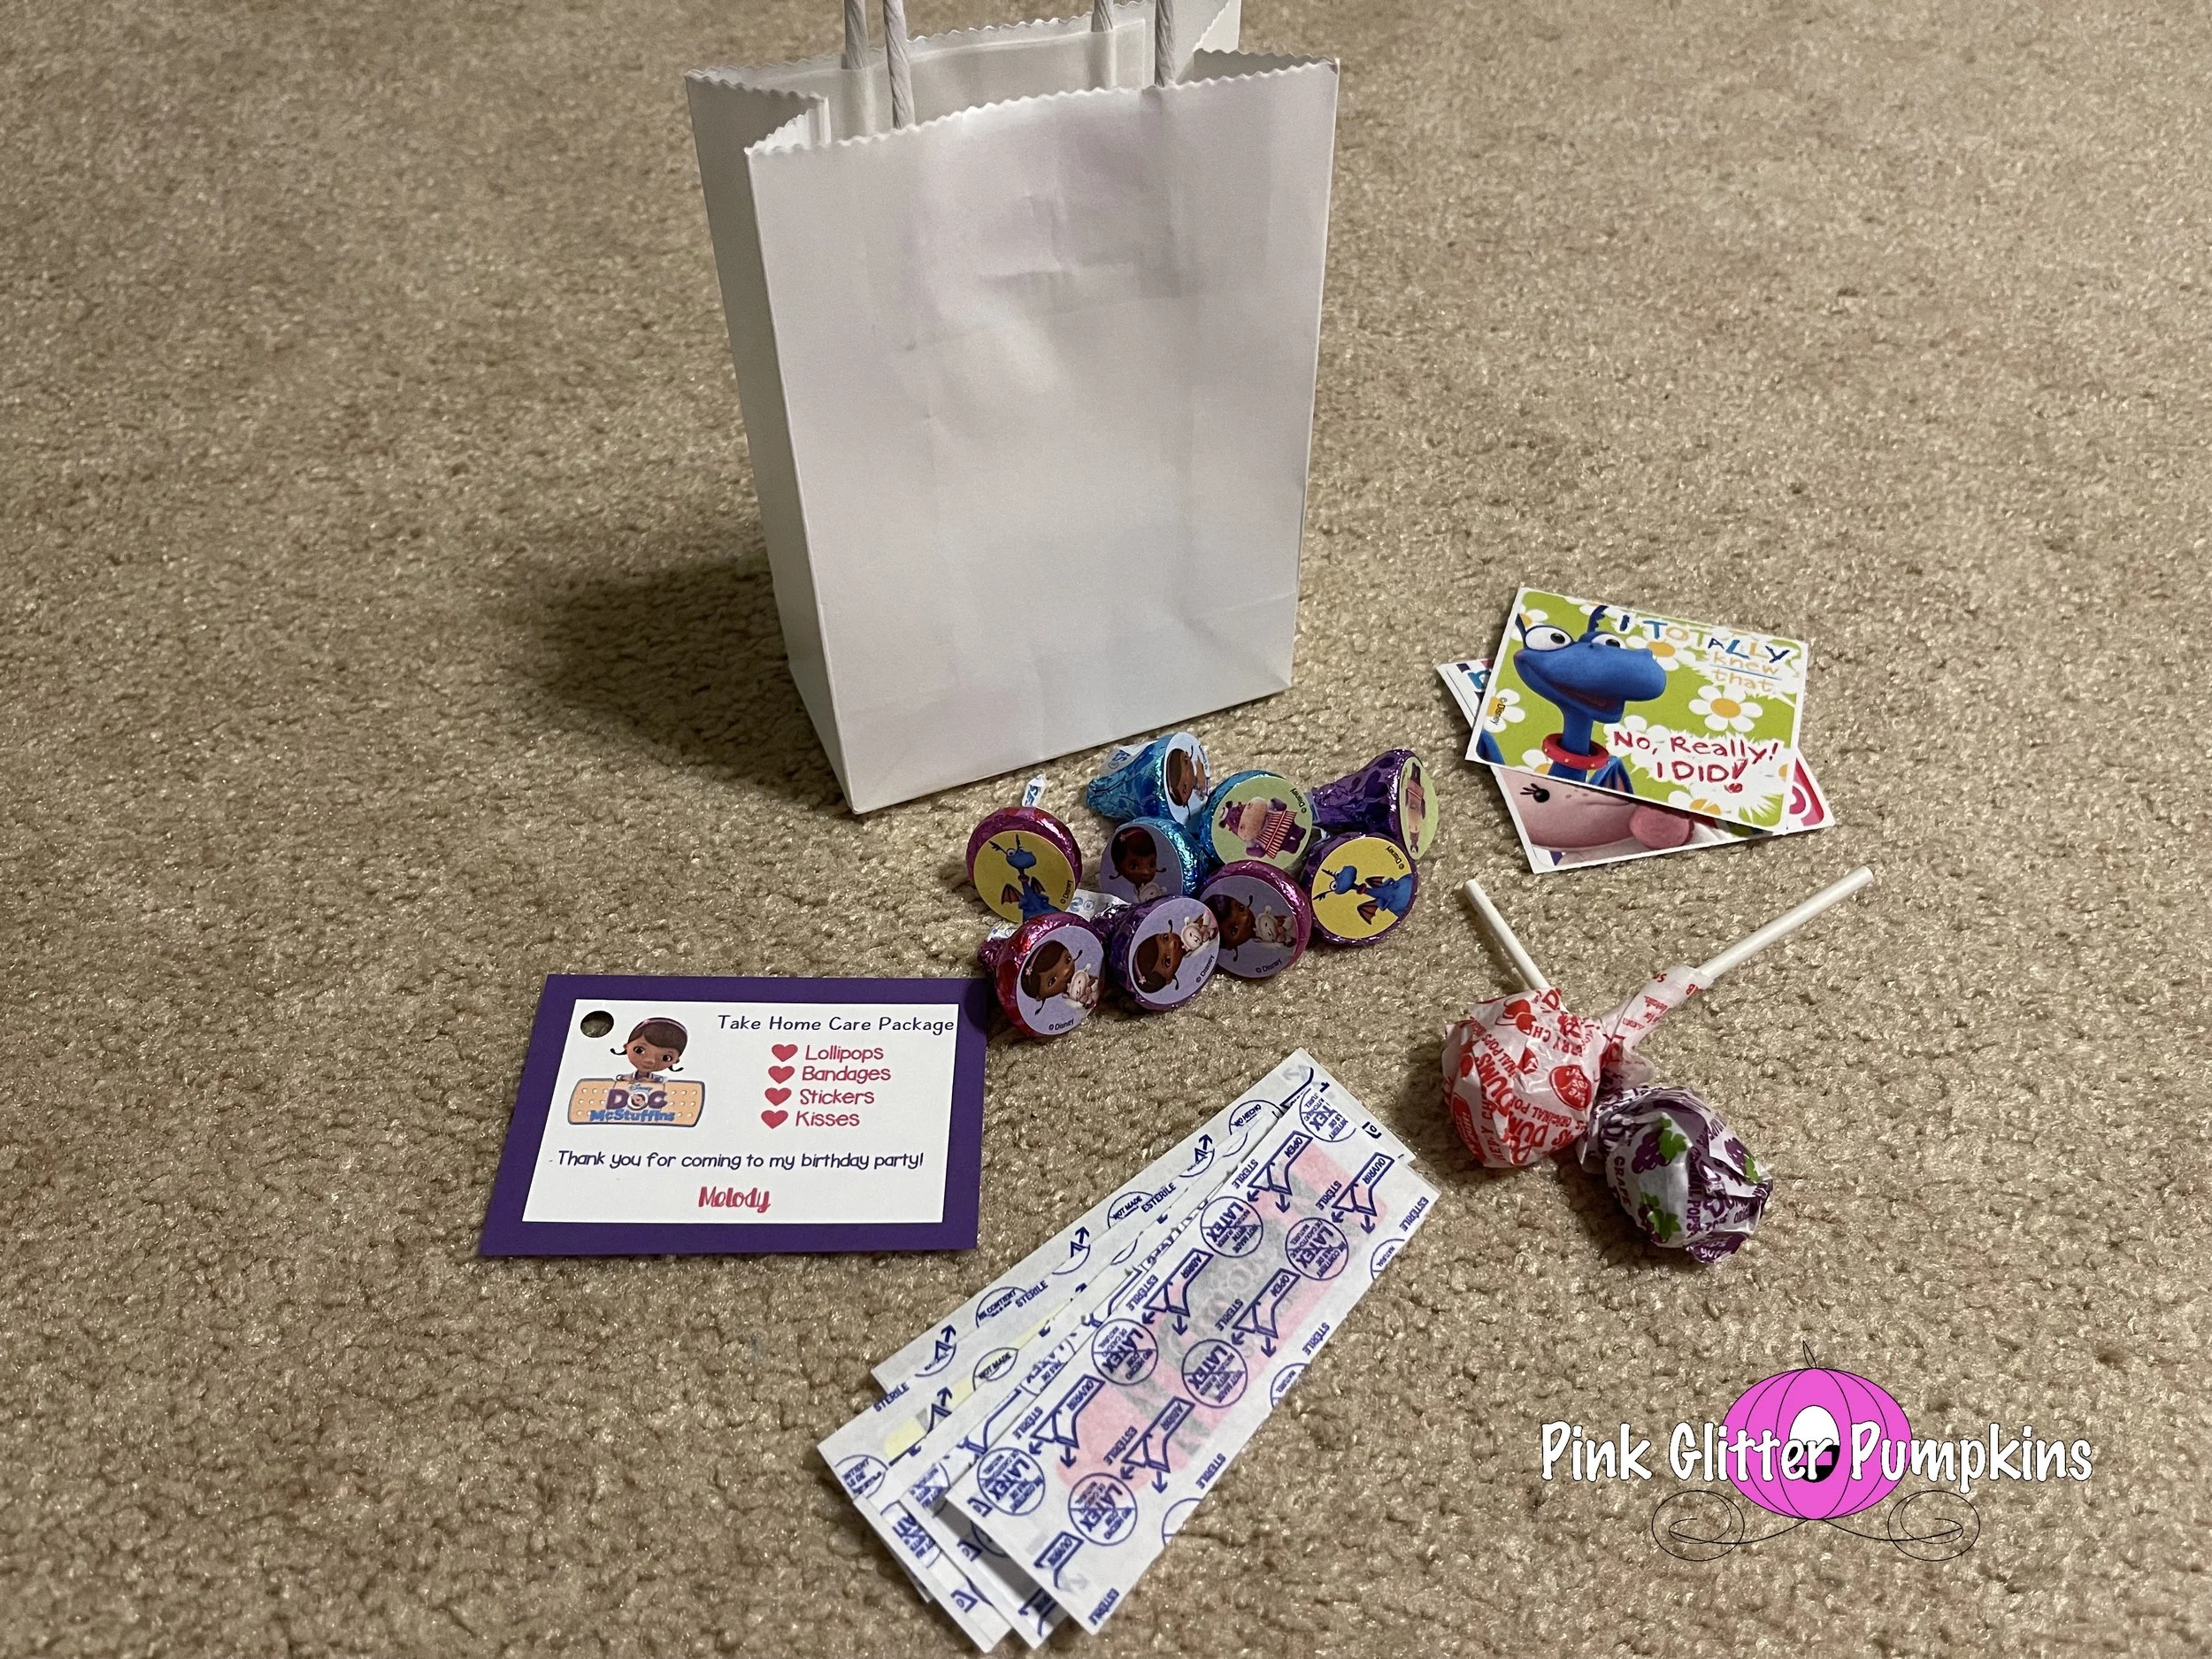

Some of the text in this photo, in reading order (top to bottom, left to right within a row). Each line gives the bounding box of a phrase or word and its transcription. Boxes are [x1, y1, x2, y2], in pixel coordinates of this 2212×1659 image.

[1618, 615, 1791, 664] I TOTALLY
[1712, 650, 1779, 675] knew
[1713, 667, 1774, 693] that
[1671, 734, 1778, 762] Really!
[1673, 758, 1748, 794] DID!
[1291, 787, 1306, 809] Disney
[1386, 845, 1402, 864] Disney
[1201, 955, 1215, 977] Disney
[1263, 958, 1282, 972] Disney
[718, 1015, 954, 1035] Take Home Care Package
[1055, 1018, 1075, 1030] Disney
[805, 1045, 884, 1063] Lollipops
[1481, 1033, 1501, 1056] POPS
[802, 1065, 892, 1085] Bandages
[800, 1088, 875, 1105] Stickers
[589, 1110, 675, 1122] McStuffins
[796, 1110, 860, 1127] Kisses
[1309, 1102, 1334, 1131] TEX
[1283, 1135, 1303, 1157] OPEN
[558, 1151, 924, 1171] Thank you for coming to my birthday party!
[1231, 1158, 1259, 1189] STERILE
[1361, 1156, 1386, 1185] OUVRIR
[698, 1187, 772, 1214] Melody
[1205, 1200, 1243, 1242] LATEX
[1294, 1225, 1333, 1268] LATEX
[1179, 1253, 1203, 1279] ABRIR
[1269, 1273, 1291, 1296] OPEN
[1213, 1298, 1244, 1331] STERILE
[1186, 1344, 1228, 1389] LATEX
[1065, 1379, 1094, 1411] OUVRIR
[1158, 1402, 1185, 1431] ABRIR
[987, 1455, 1031, 1502] LATEX
[1194, 1452, 1226, 1489] STERILE
